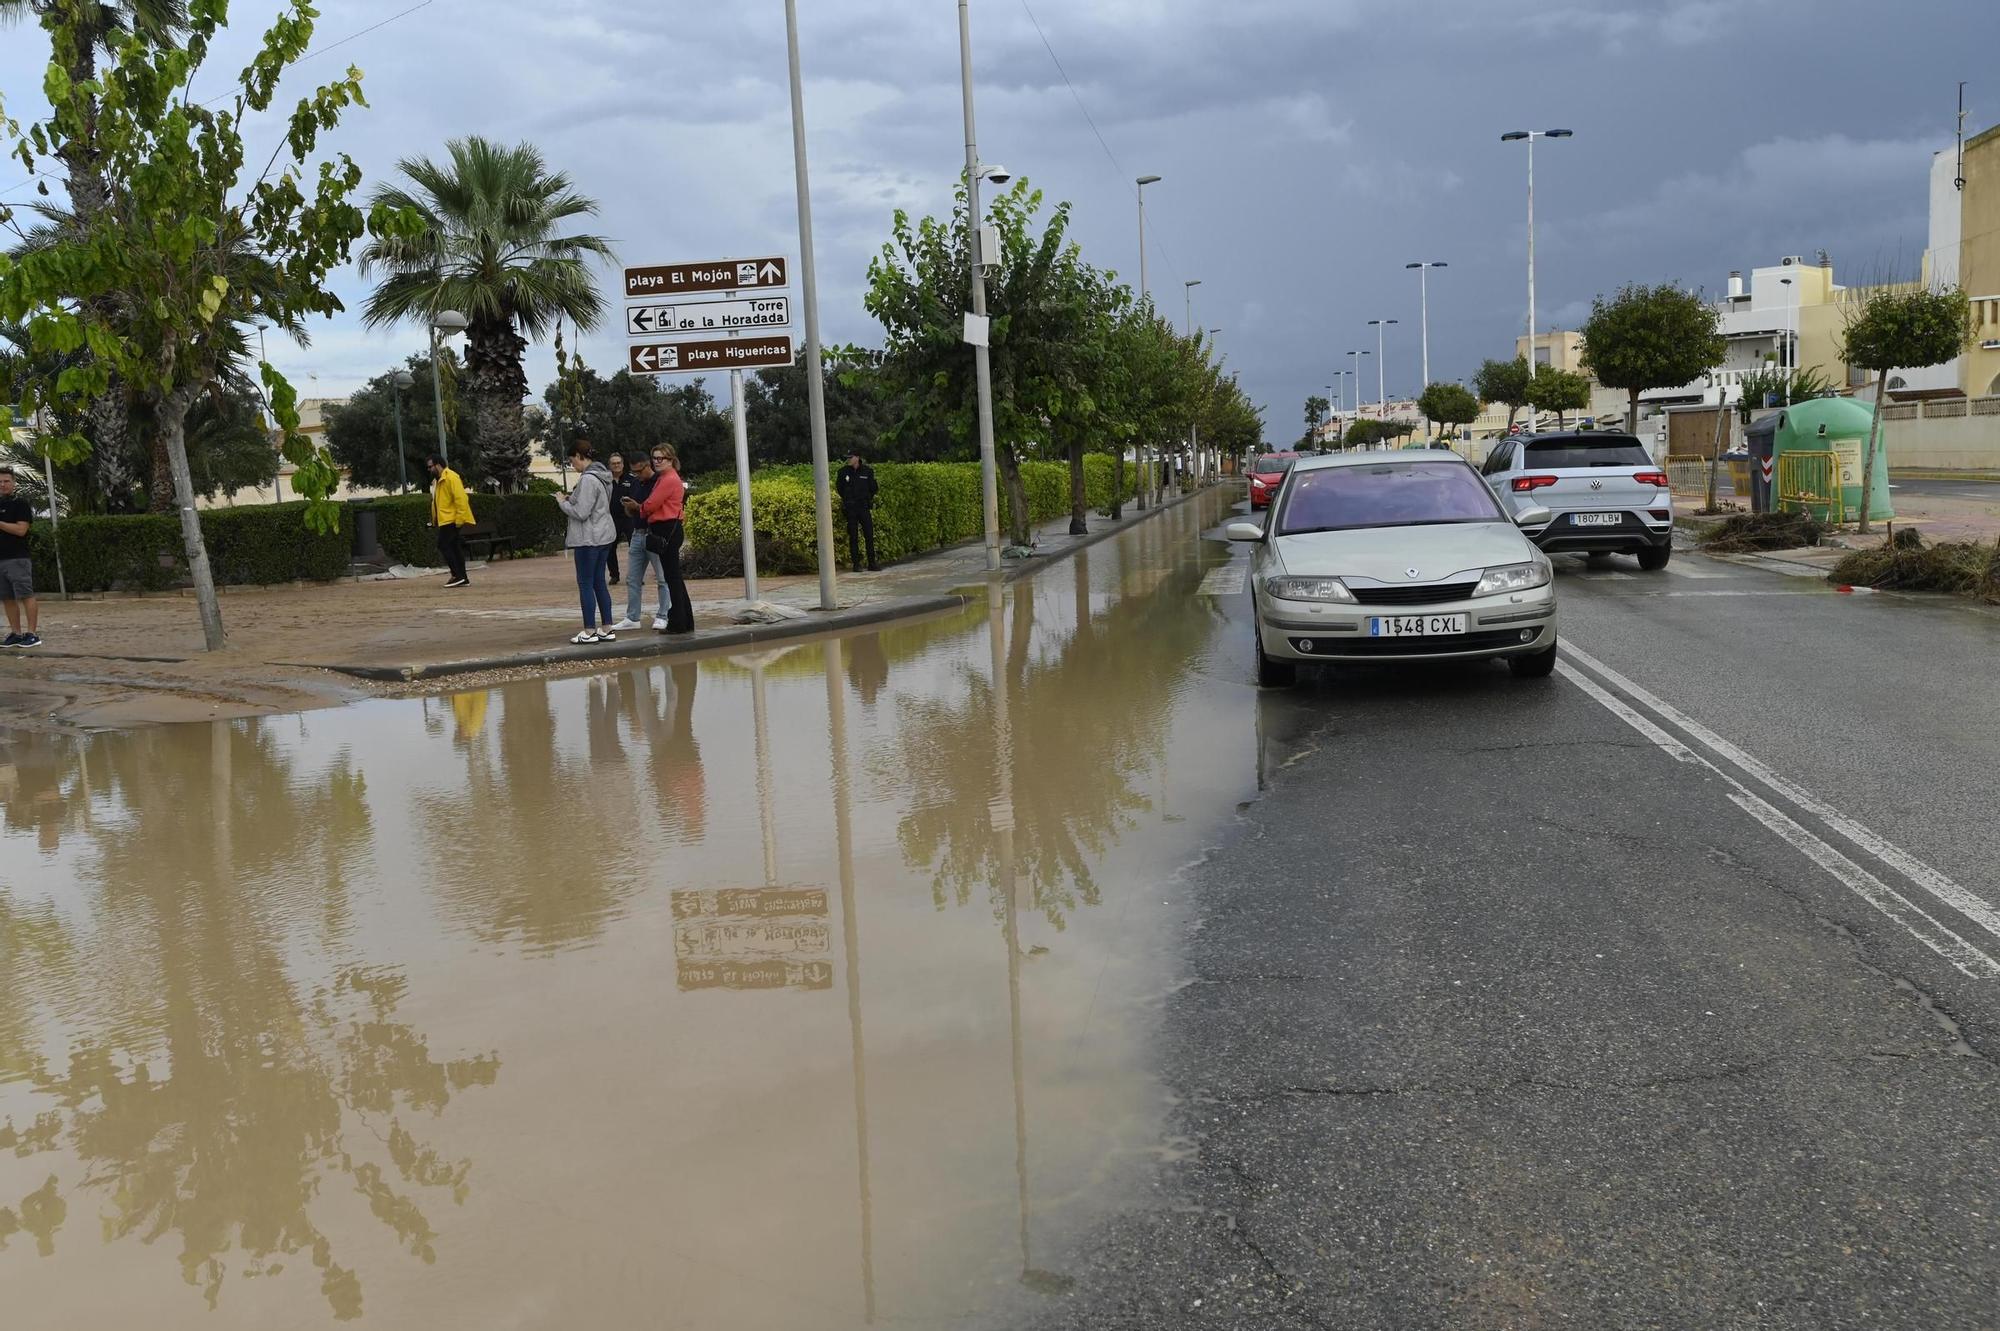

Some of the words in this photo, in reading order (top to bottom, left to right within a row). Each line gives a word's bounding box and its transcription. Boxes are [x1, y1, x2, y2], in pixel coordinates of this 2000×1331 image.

[629, 275, 663, 288] playa
[672, 273, 684, 283] El
[692, 269, 731, 283] Mojón
[749, 301, 783, 312] Torre
[680, 318, 694, 328] de
[703, 317, 713, 326] la
[722, 313, 783, 326] Horadada
[688, 348, 718, 362] playa
[726, 345, 787, 360] Higuericas
[1602, 514, 1619, 522] LBW
[1385, 619, 1424, 633] 1548
[1431, 618, 1461, 632] CXL
